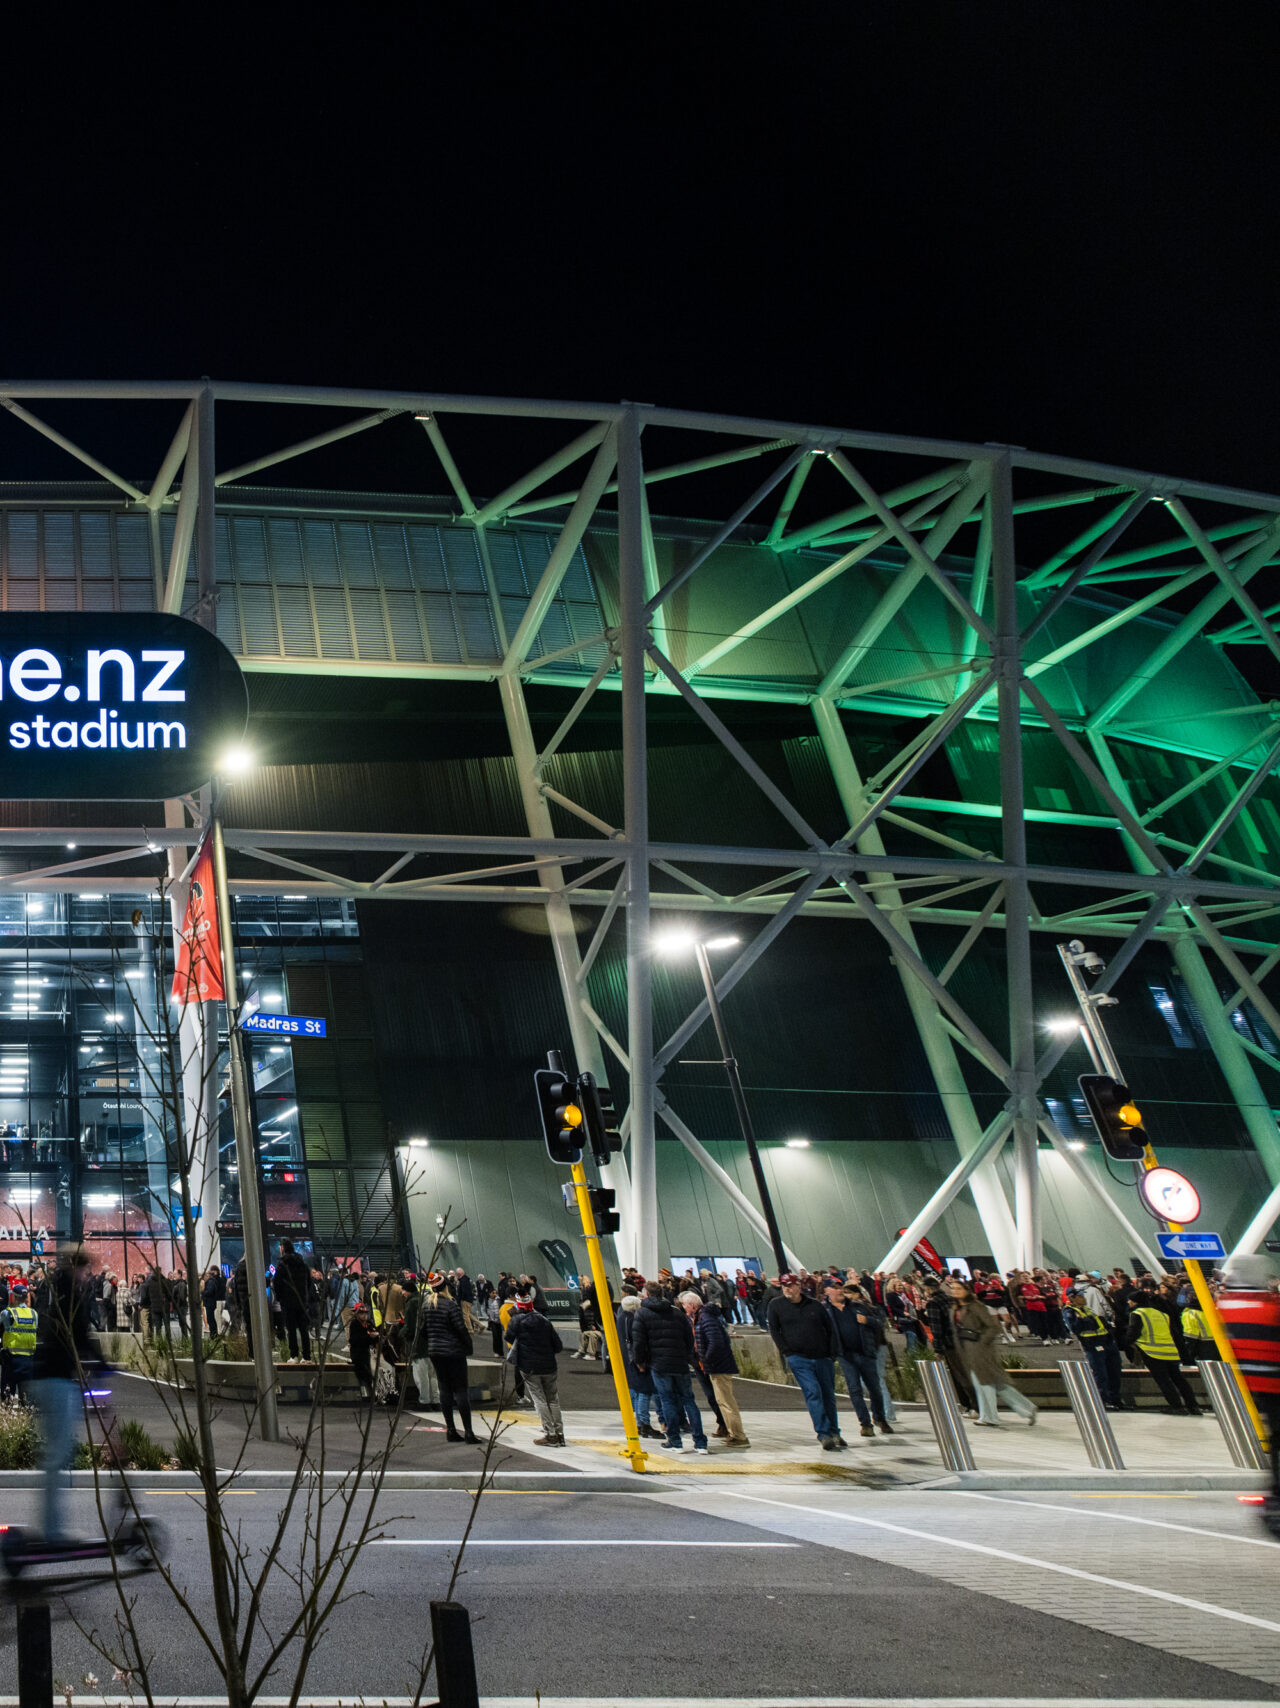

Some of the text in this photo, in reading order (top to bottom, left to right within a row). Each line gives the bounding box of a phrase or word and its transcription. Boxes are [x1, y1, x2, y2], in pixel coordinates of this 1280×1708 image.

[9, 709, 186, 749] stadium
[247, 1016, 321, 1033] Madras St
[36, 1226, 49, 1240] A
[35, 1243, 42, 1252] A
